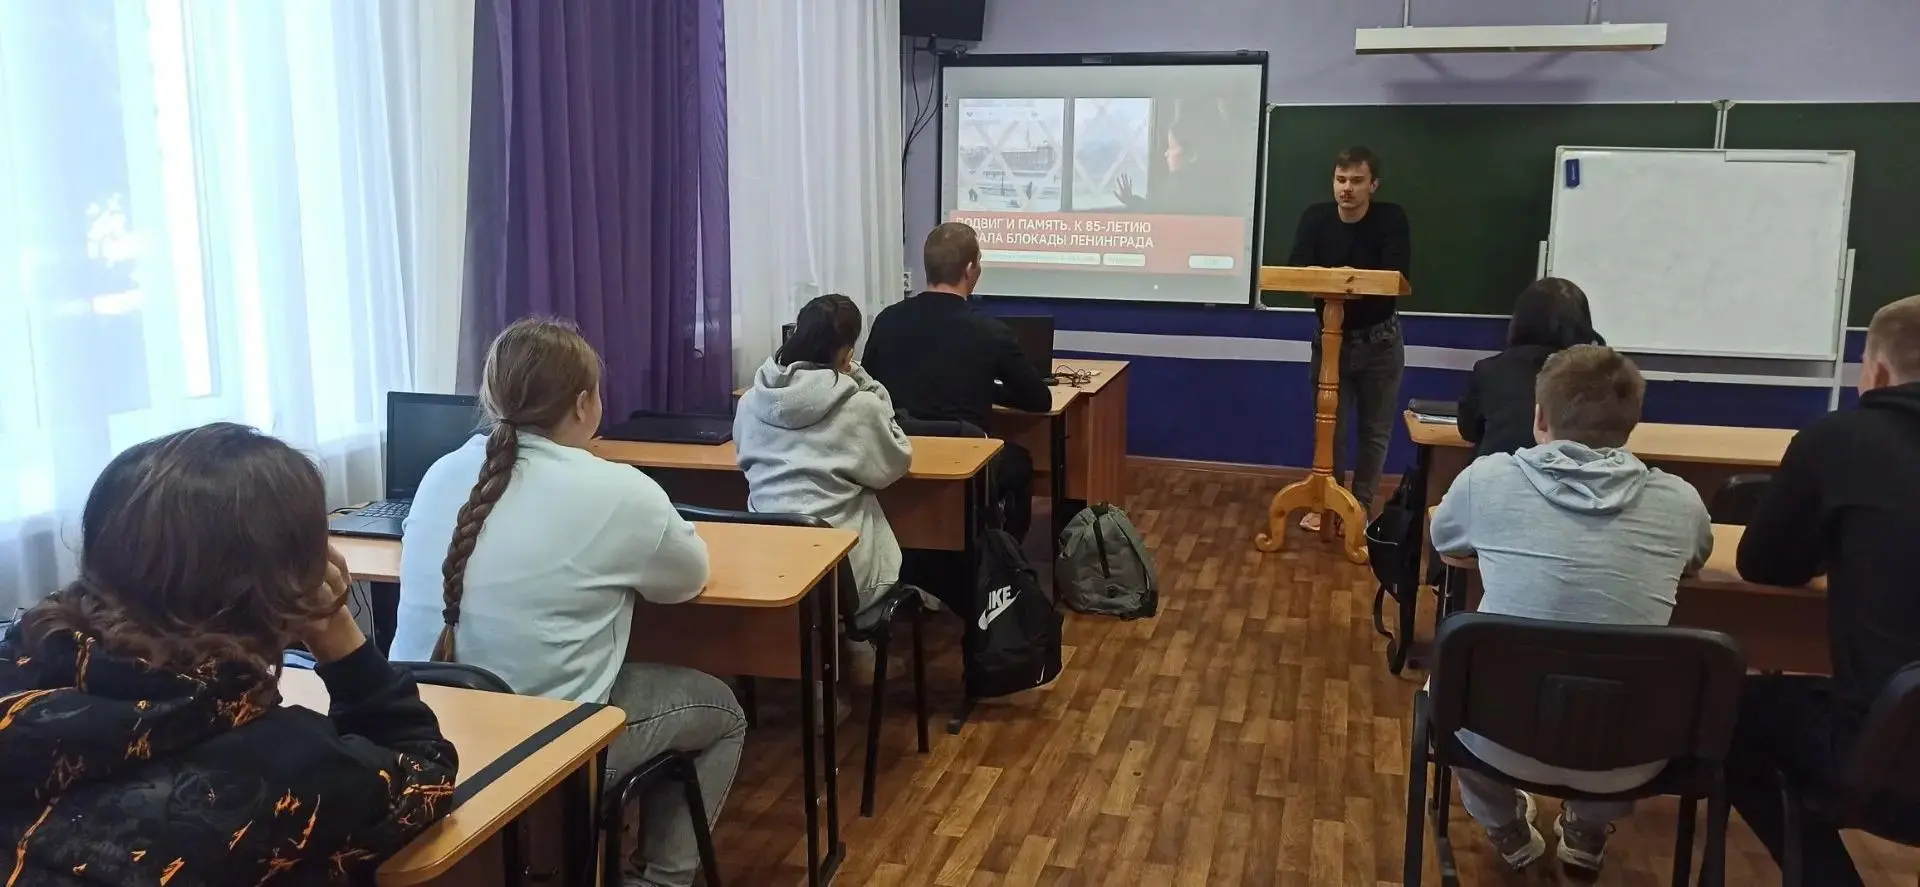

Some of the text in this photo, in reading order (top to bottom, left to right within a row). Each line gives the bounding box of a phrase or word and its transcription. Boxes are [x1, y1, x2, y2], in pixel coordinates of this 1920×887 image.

[1006, 218, 1015, 229] И
[1018, 218, 1071, 231] ПАМЯТЬ.
[1074, 220, 1082, 231] К
[1086, 220, 1151, 233] 85-ЛЕТИЮ
[1006, 233, 1067, 246] БЛОКАДЫ
[1070, 234, 1154, 248] ЛЕНИНГРАДА
